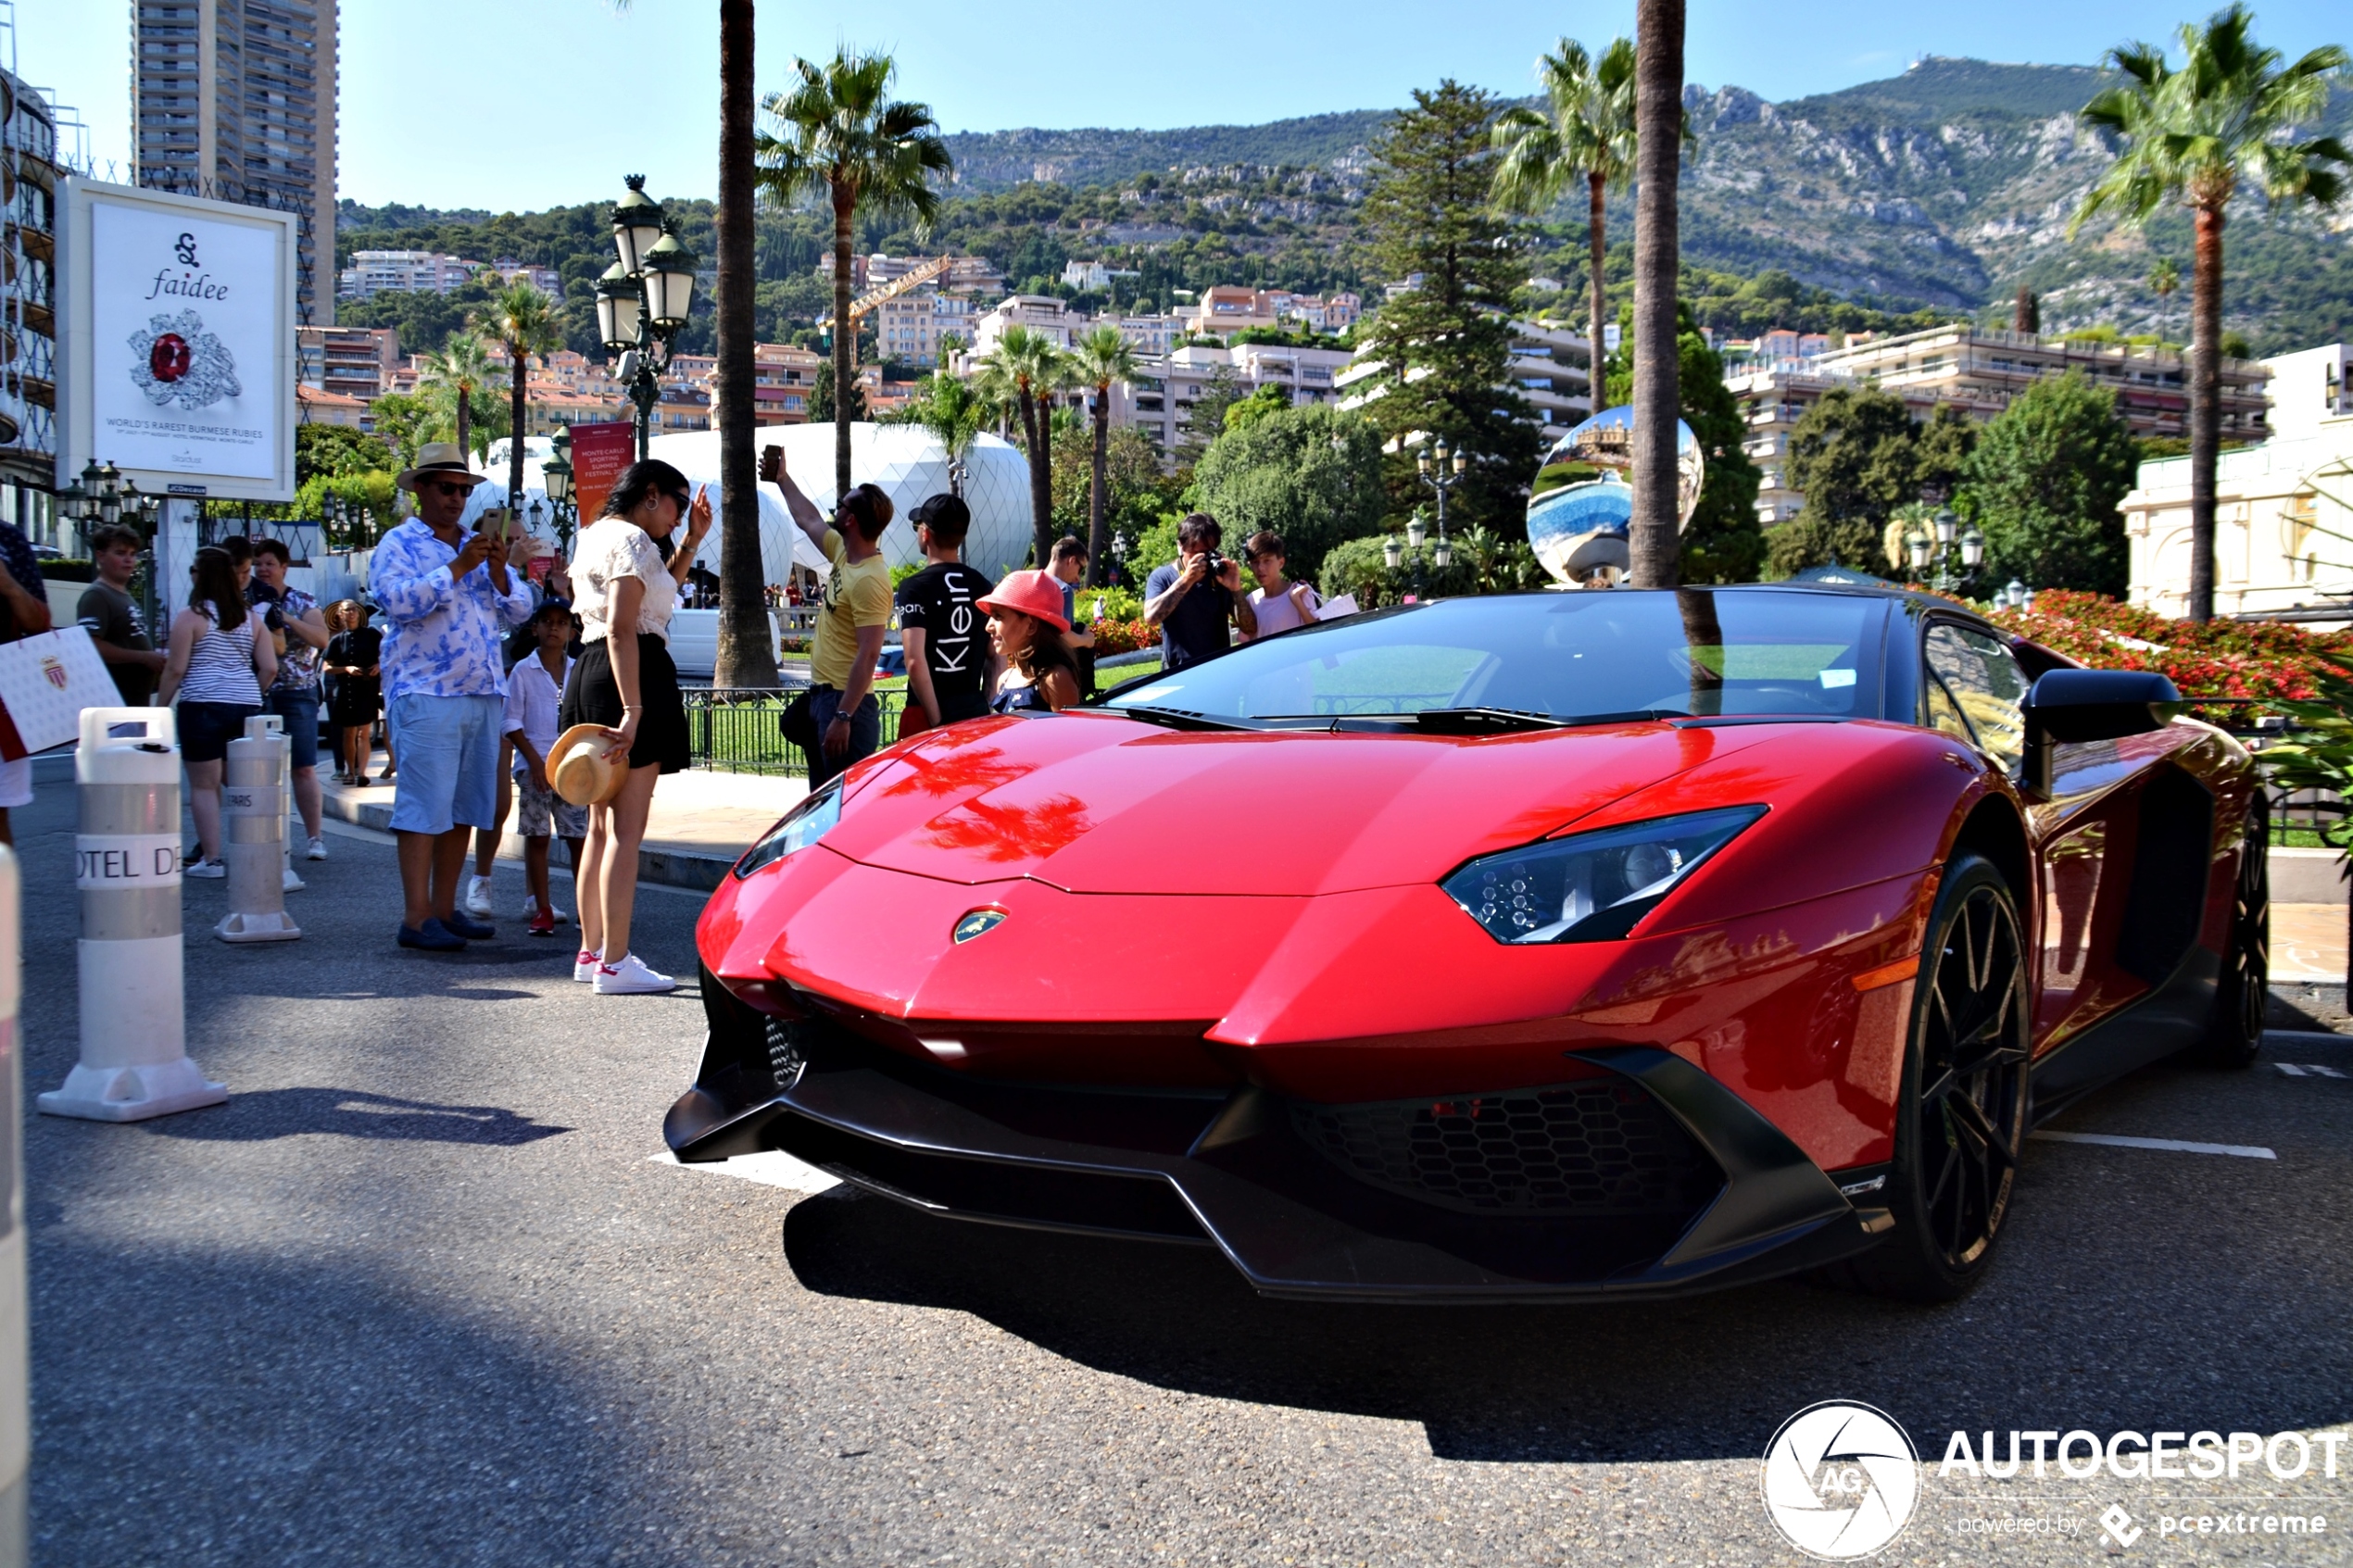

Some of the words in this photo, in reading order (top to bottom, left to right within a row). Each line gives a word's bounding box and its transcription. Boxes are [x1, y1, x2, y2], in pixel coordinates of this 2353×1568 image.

[145, 268, 228, 301] faidee
[106, 418, 149, 429] WORLD'S
[151, 421, 186, 432] RAREST
[188, 424, 230, 436] BURMESE
[232, 428, 262, 439] RUBIES
[169, 485, 206, 494] JCDecaux
[935, 572, 972, 672] Klein
